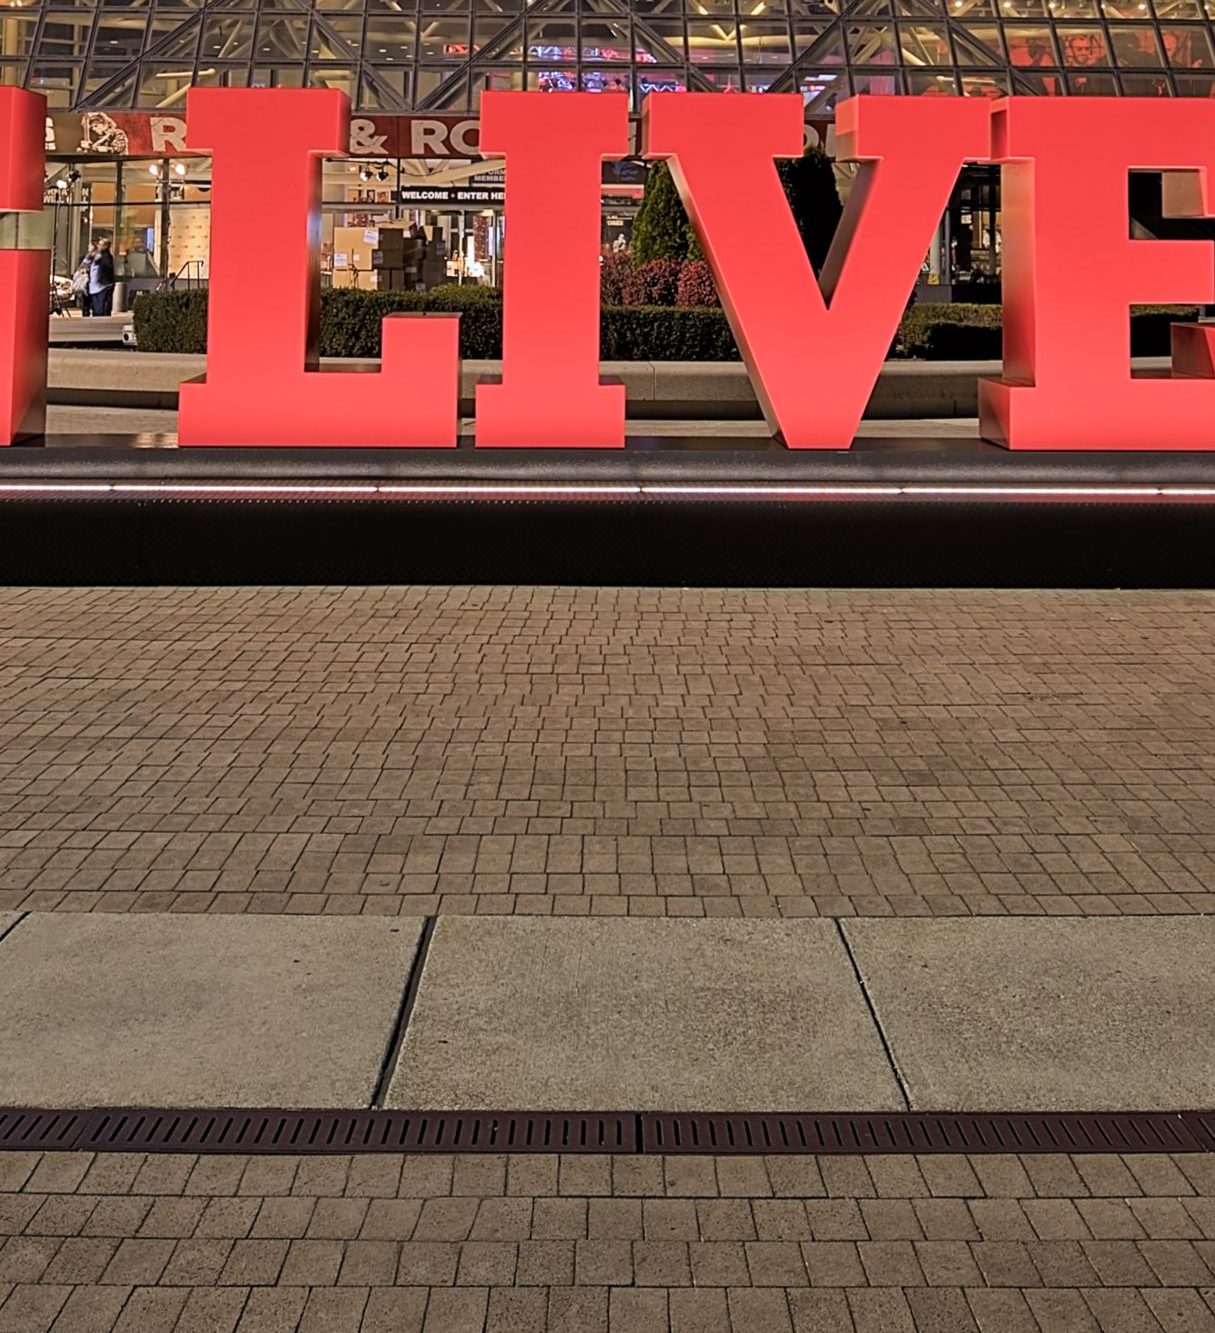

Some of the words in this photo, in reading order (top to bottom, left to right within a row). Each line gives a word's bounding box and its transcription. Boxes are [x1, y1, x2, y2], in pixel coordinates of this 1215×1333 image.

[350, 119, 389, 155] &
[411, 119, 481, 156] RO
[401, 191, 449, 200] WELCOME
[457, 192, 490, 200] ENTER
[491, 192, 505, 201] HE
[178, 87, 1215, 450] LIVE
